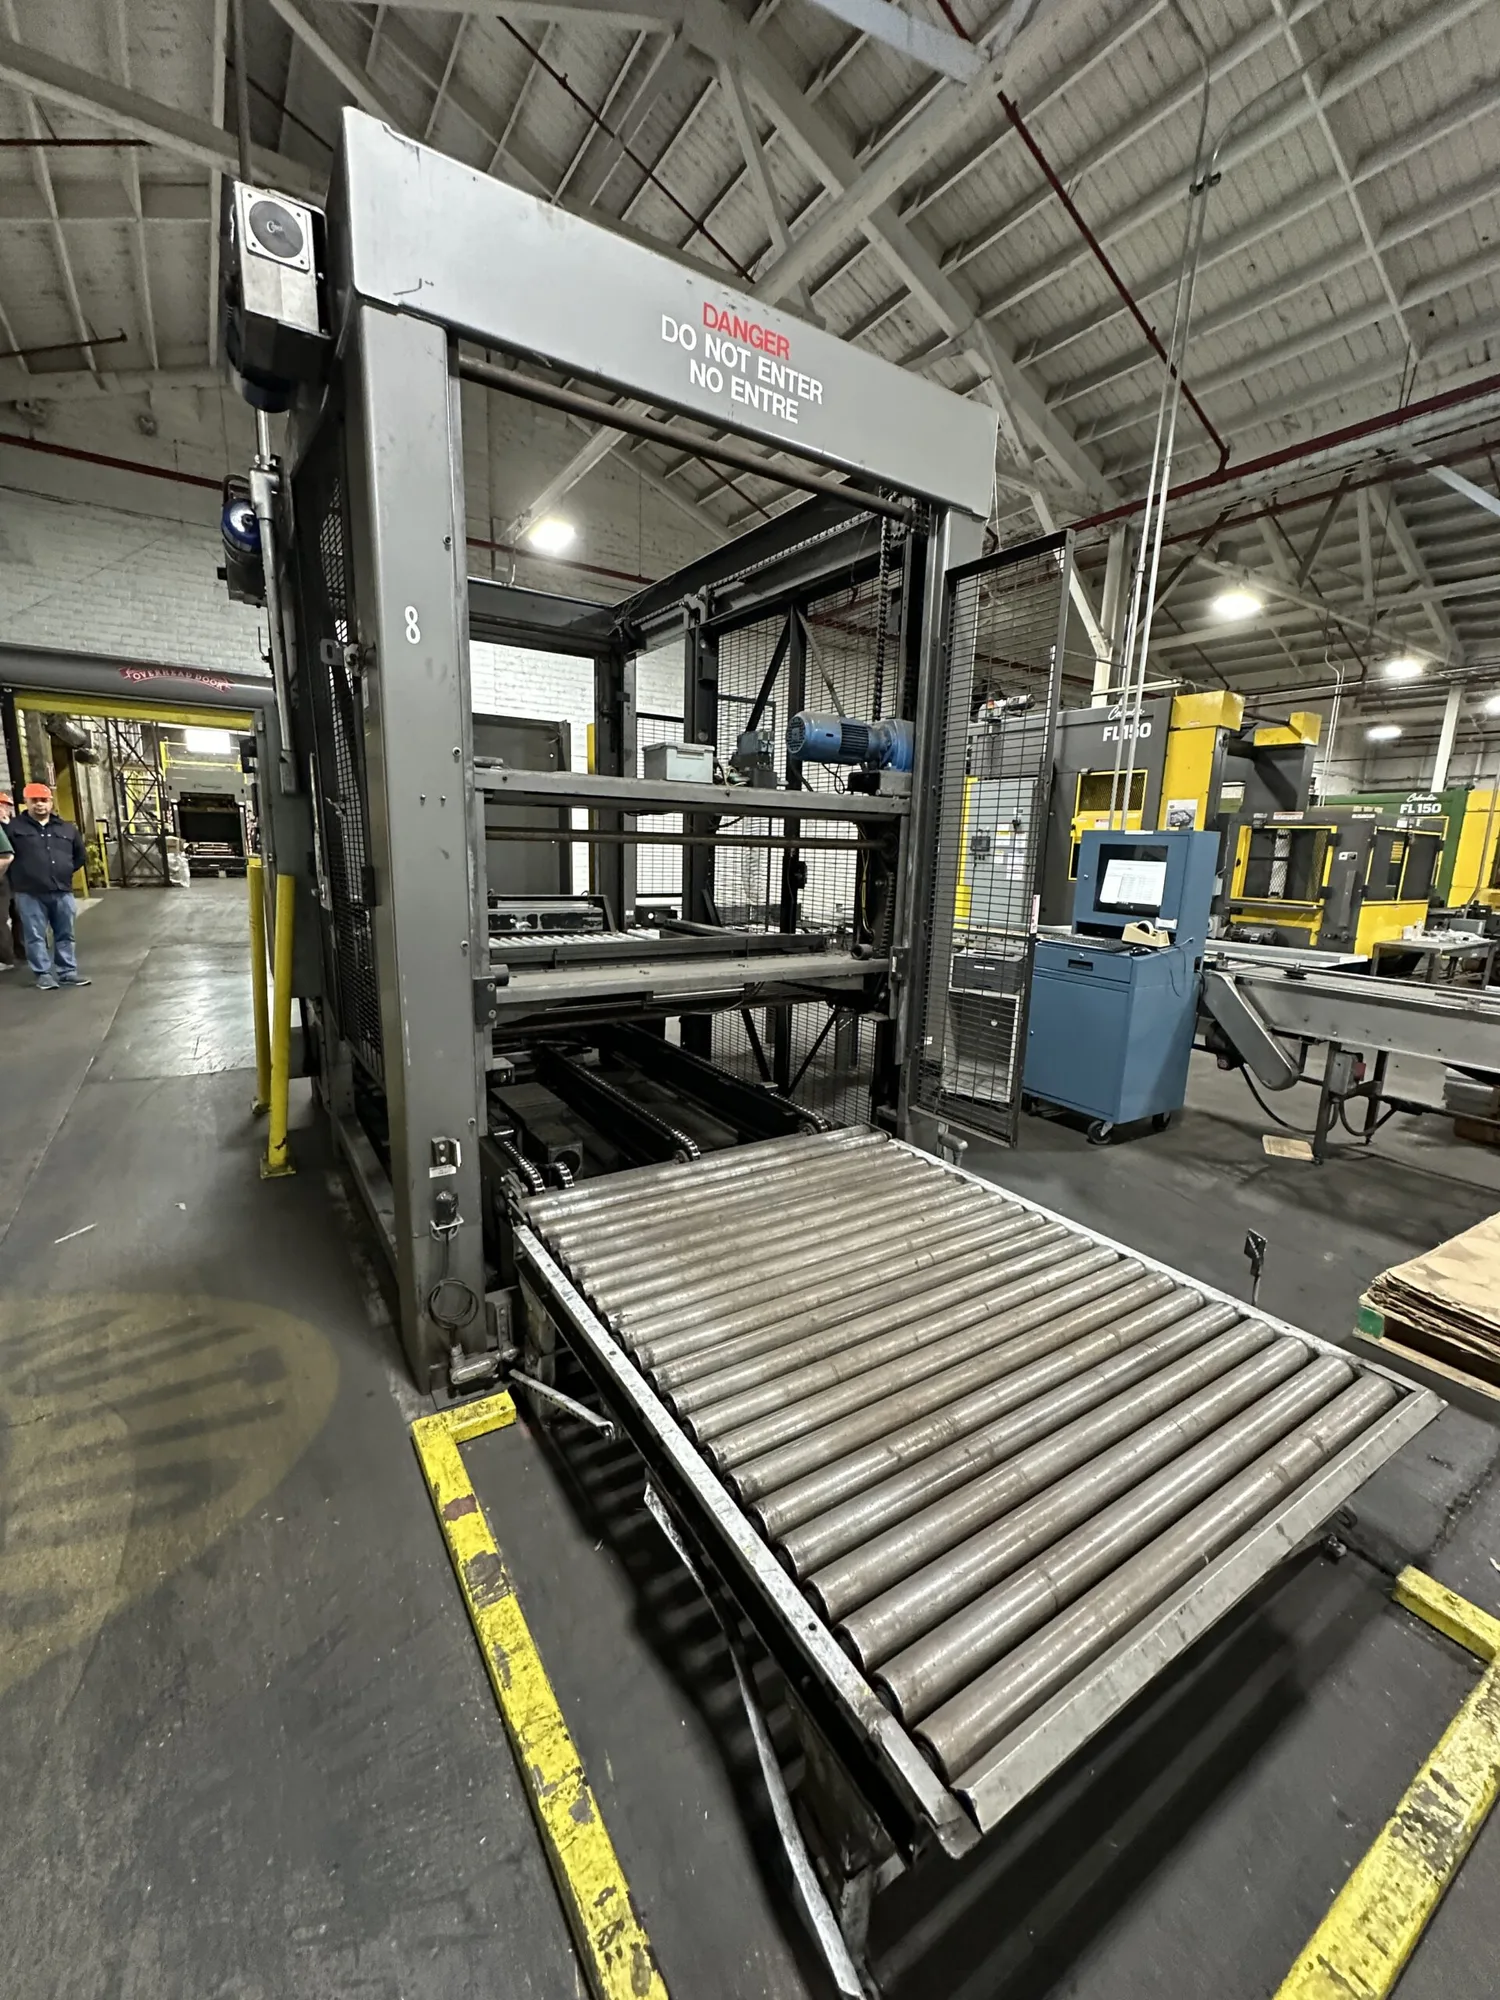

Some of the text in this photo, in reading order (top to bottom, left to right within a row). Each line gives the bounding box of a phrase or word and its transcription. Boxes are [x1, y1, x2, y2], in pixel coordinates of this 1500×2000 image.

[661, 314, 823, 404] DO NOT ENTER
[703, 302, 790, 360] DANGER
[689, 359, 799, 424] NO ENTRE
[404, 605, 421, 645] 8
